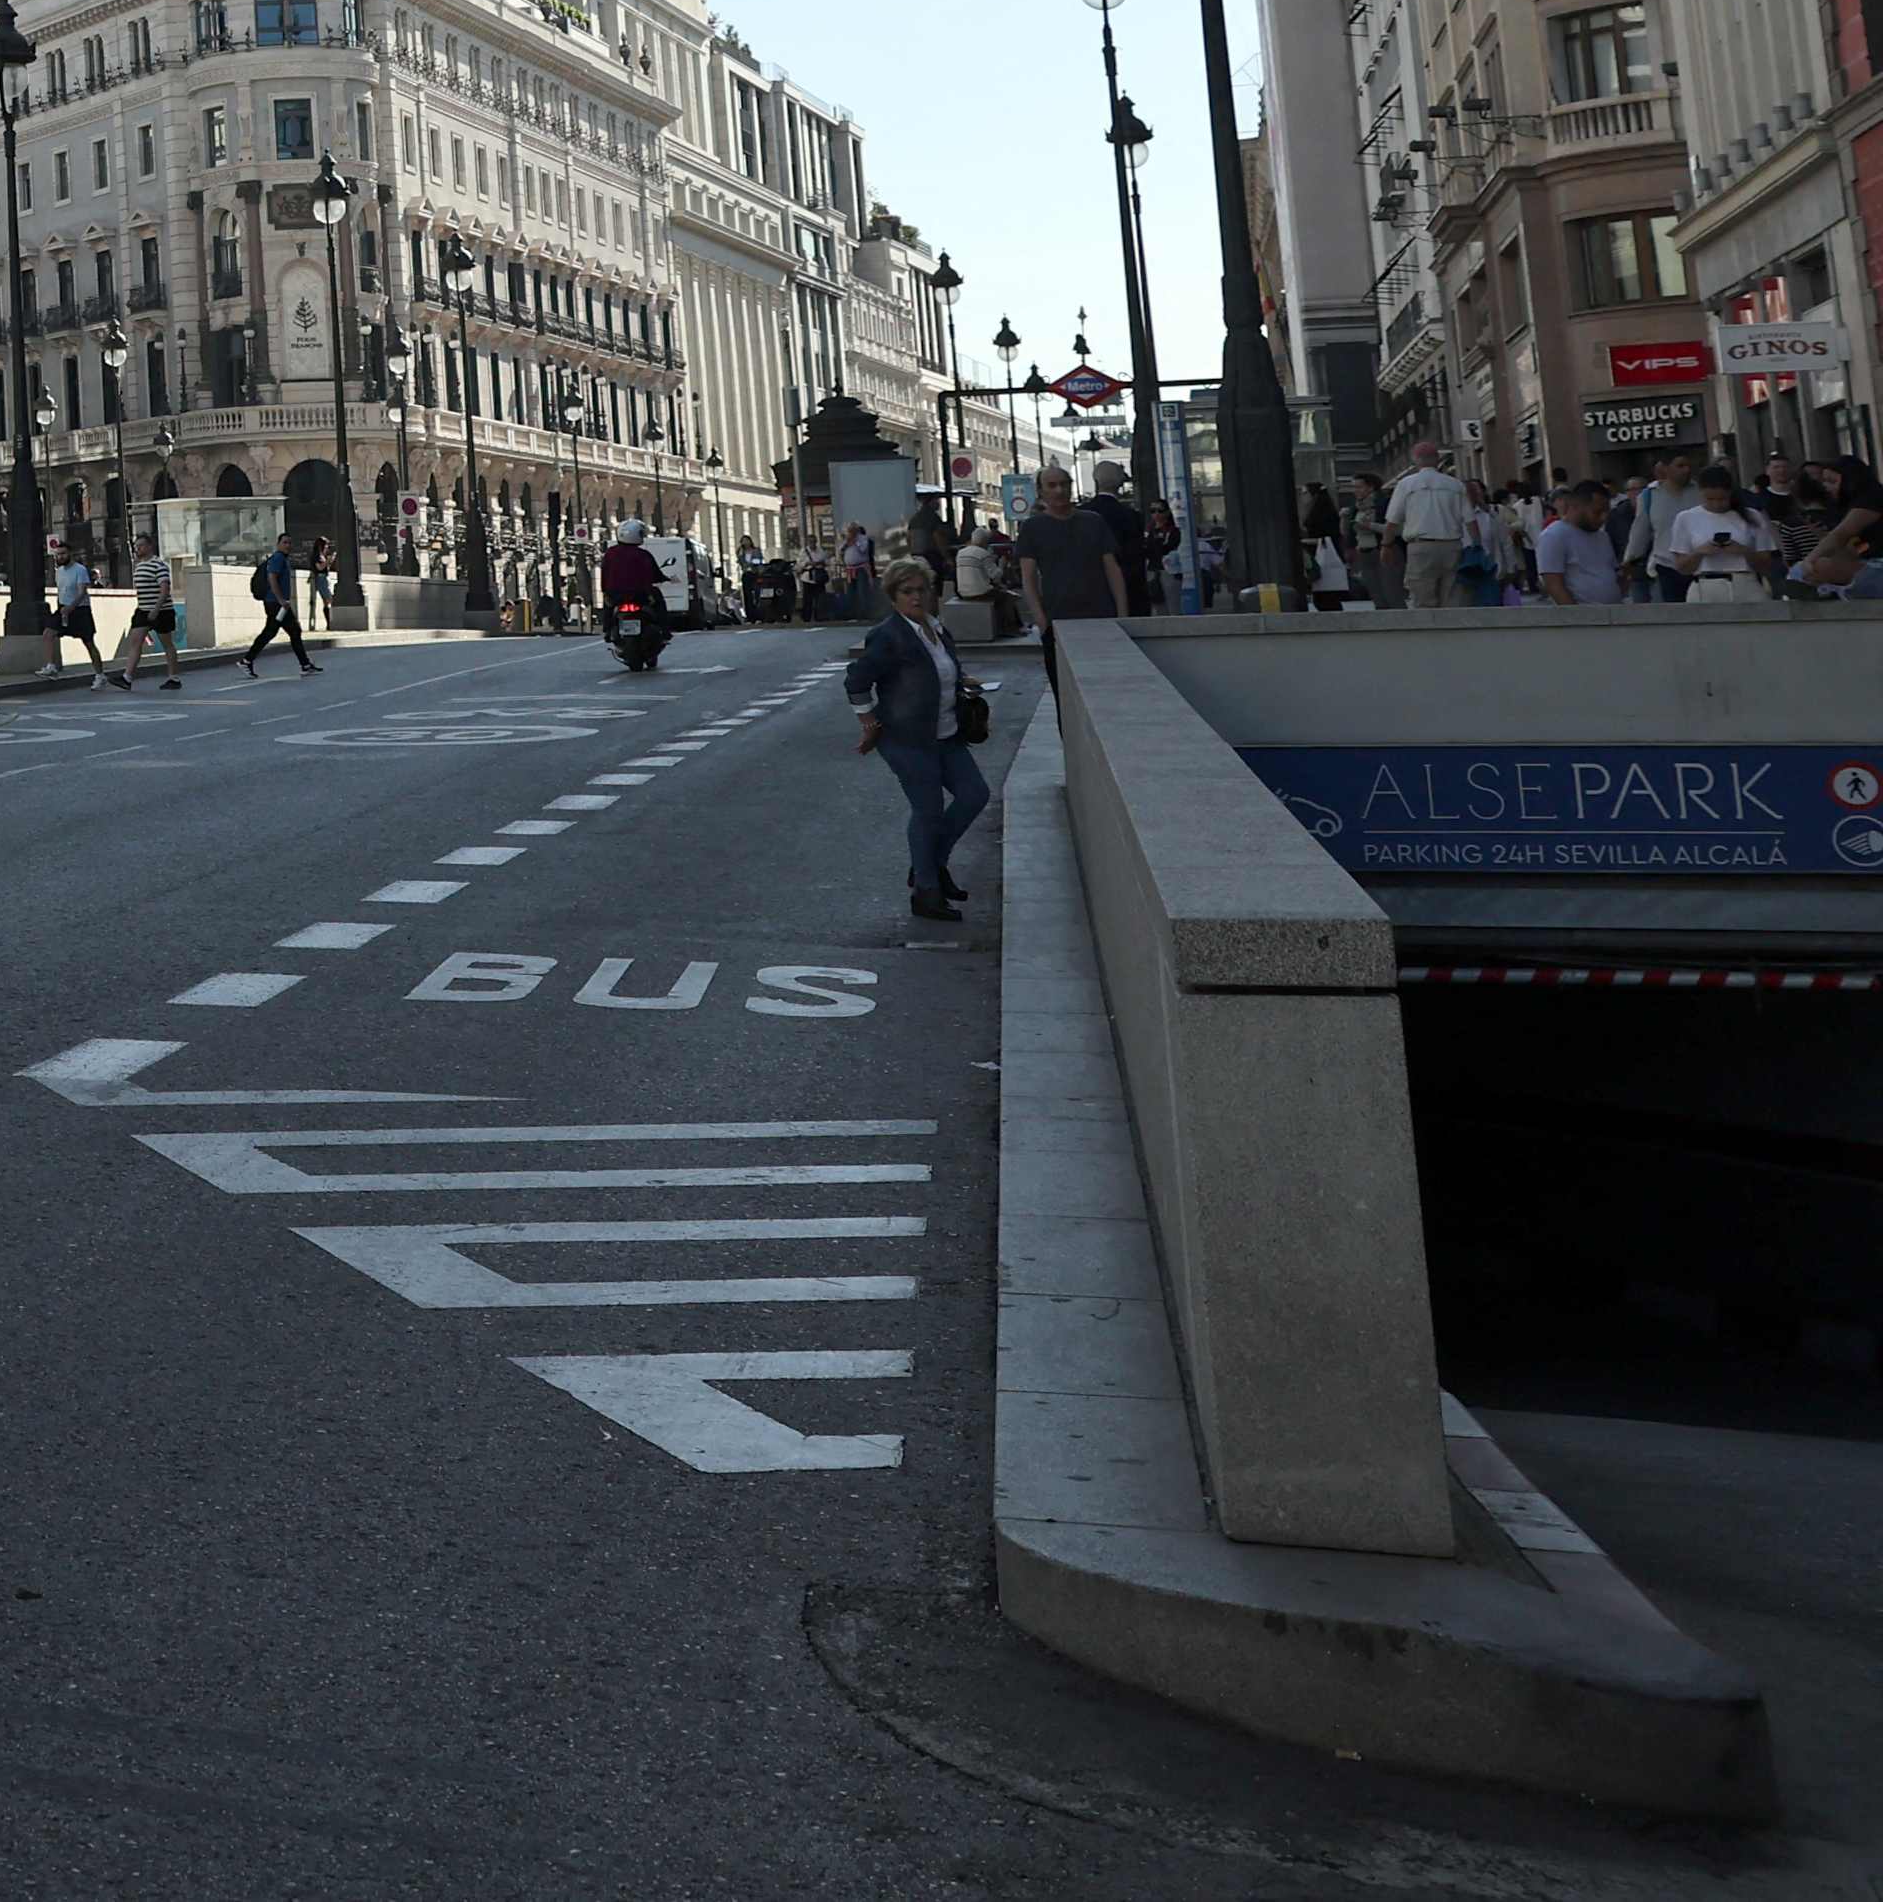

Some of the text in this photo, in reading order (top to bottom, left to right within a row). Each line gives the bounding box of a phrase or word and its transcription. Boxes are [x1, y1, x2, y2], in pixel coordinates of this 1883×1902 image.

[1727, 339, 1828, 360] GINOS
[1616, 356, 1700, 370] VIPS
[1067, 381, 1104, 393] Metro
[1583, 402, 1694, 427] STARBUCKS
[1606, 422, 1676, 443] COFFEE
[353, 729, 515, 741] 30
[1360, 762, 1786, 822] ALSEPARK
[1363, 838, 1789, 866] PARKING 24H SEVILLA ALCALÁ
[402, 951, 879, 1018] BUS
